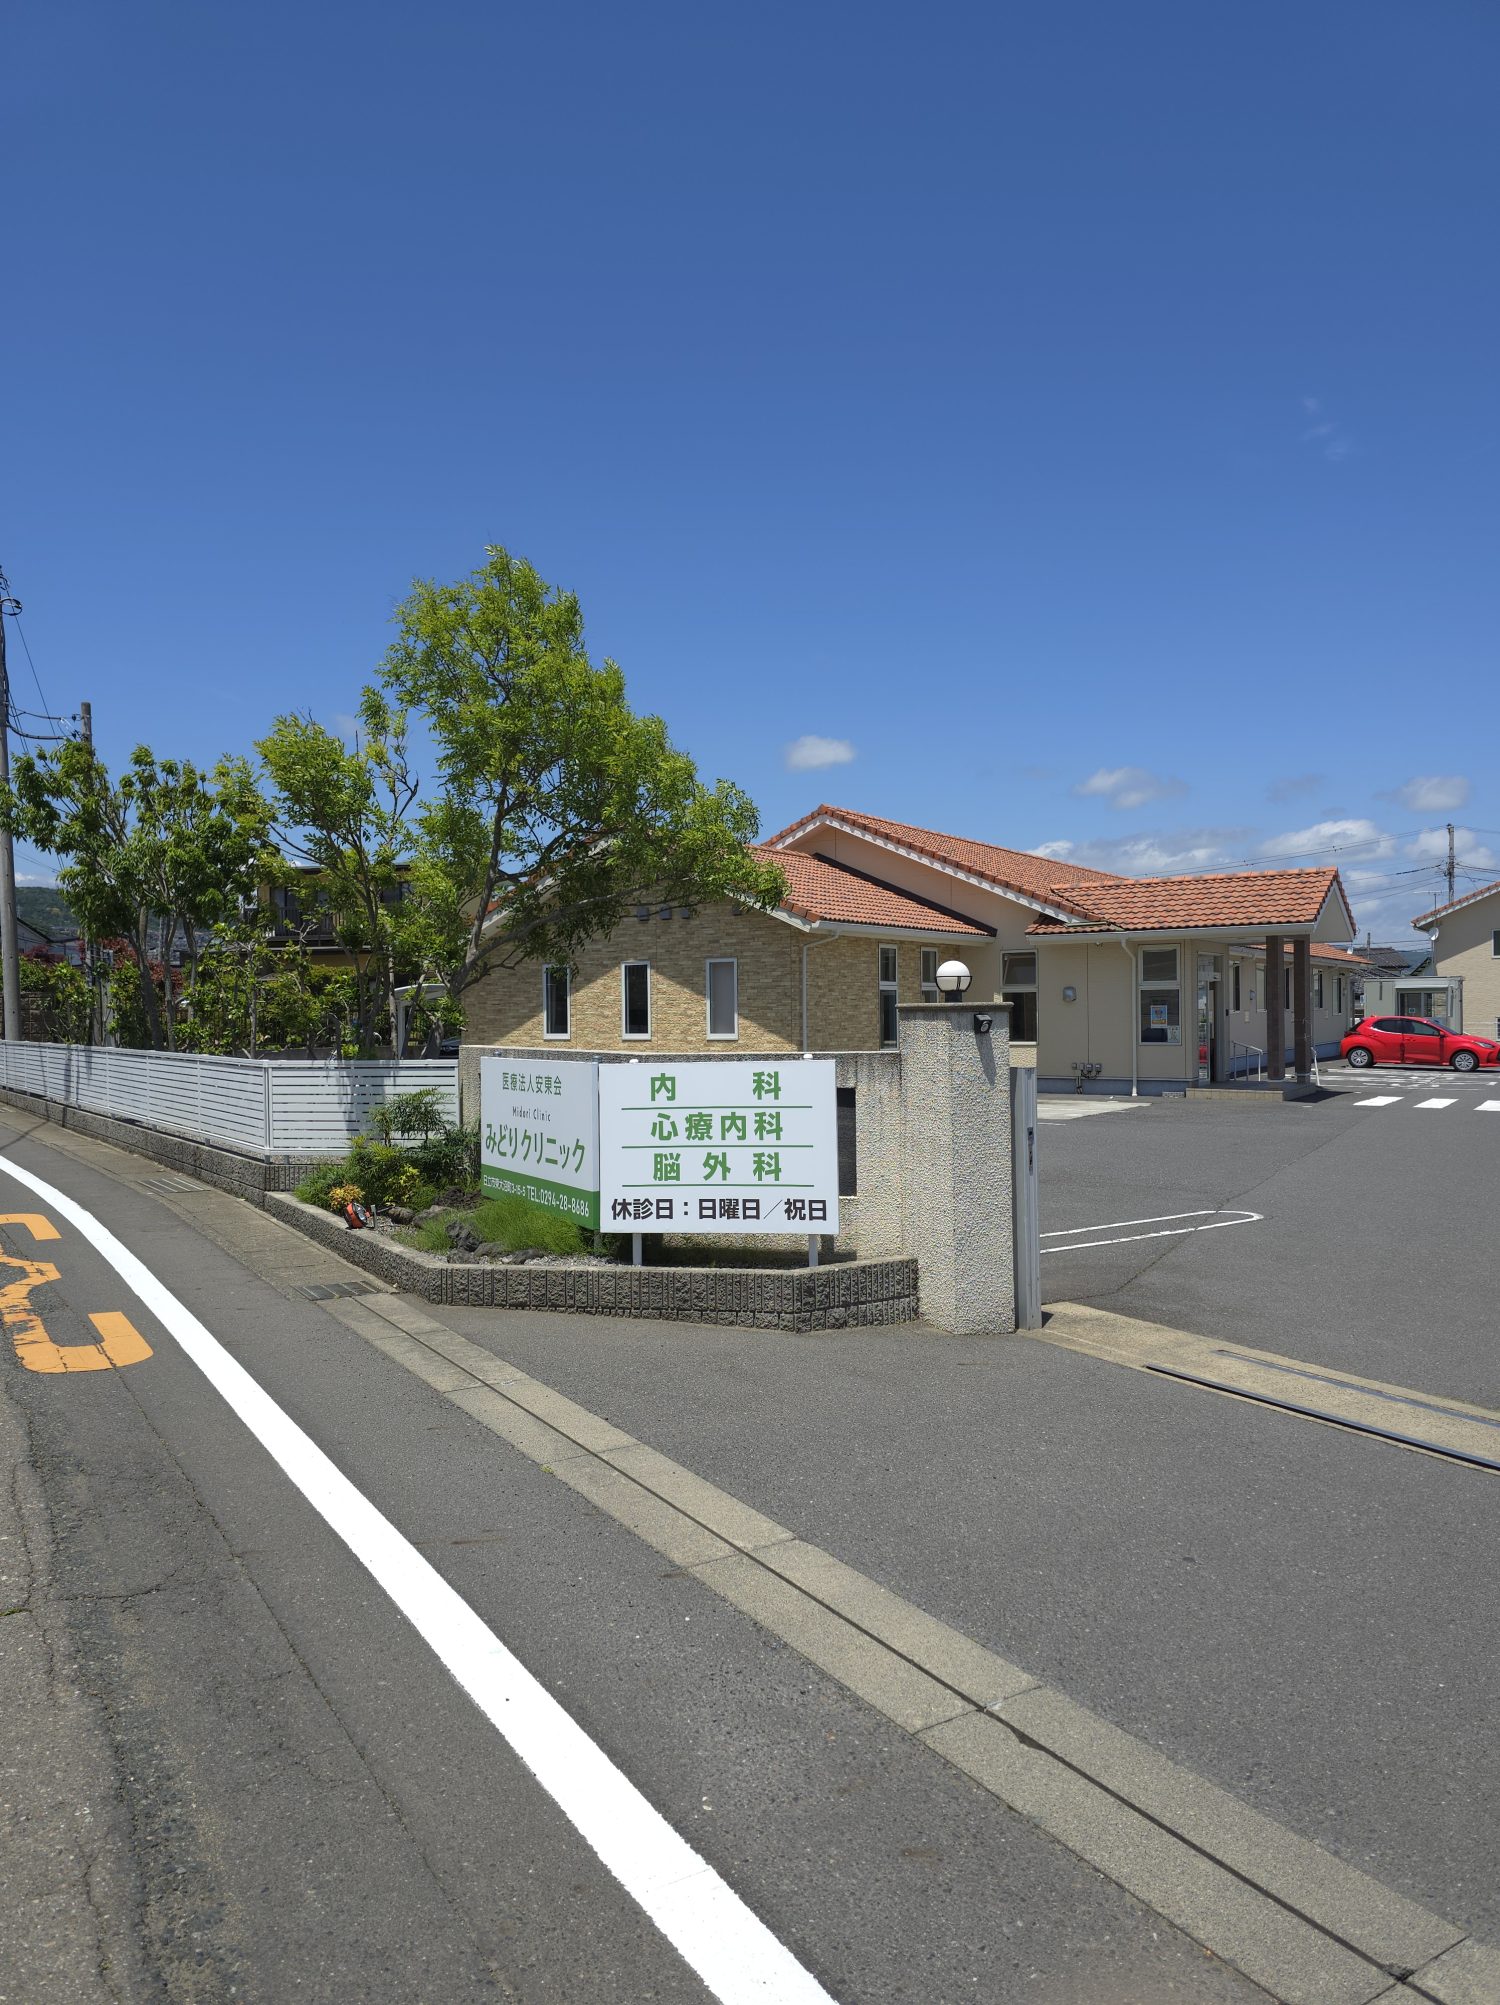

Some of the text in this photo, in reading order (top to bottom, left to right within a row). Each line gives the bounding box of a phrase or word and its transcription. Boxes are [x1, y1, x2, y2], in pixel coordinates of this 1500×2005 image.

[502, 1072, 562, 1096] 医療法人安東会
[512, 1105, 552, 1122] Midori Clinic
[650, 1111, 783, 1141] 心療内科
[485, 1123, 585, 1173] みどりクリニック
[652, 1151, 782, 1182] 脳外科
[526, 1184, 590, 1218] TEL:0294-28-8686
[611, 1198, 827, 1222] 休診日：日曜日／祝日
